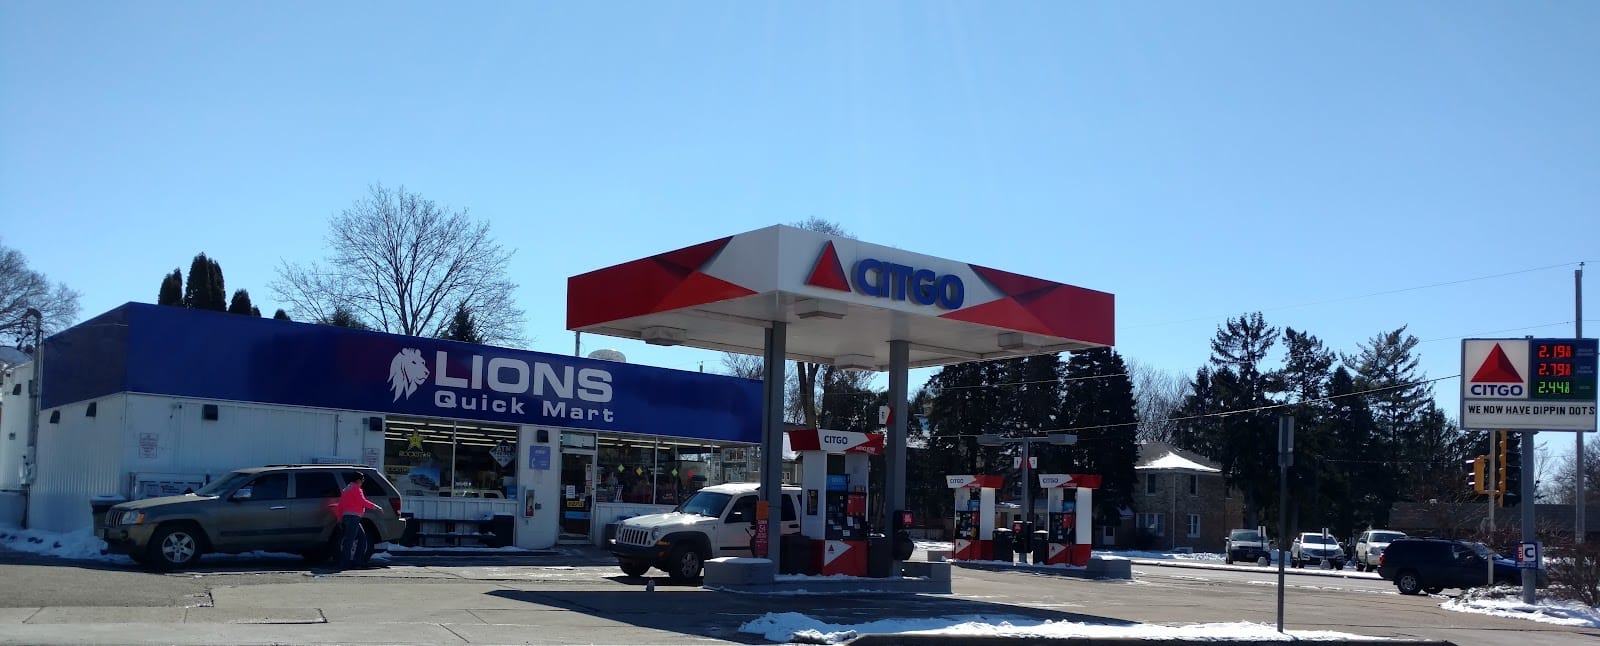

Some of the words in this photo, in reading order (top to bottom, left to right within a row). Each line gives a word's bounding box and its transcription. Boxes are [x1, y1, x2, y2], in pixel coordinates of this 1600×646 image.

[851, 258, 965, 310] CITGO
[434, 350, 613, 403] LIONS
[1470, 384, 1523, 396] CITGO
[434, 390, 526, 415] Quick
[543, 400, 614, 423] Mart
[1468, 405, 1481, 414] WE
[1483, 405, 1504, 414] NOW
[1505, 405, 1531, 415] HAVE
[1533, 406, 1566, 415] DIPPIN
[1569, 406, 1595, 415] DOTS
[824, 435, 848, 445] CITGO
[1524, 547, 1534, 558] C
